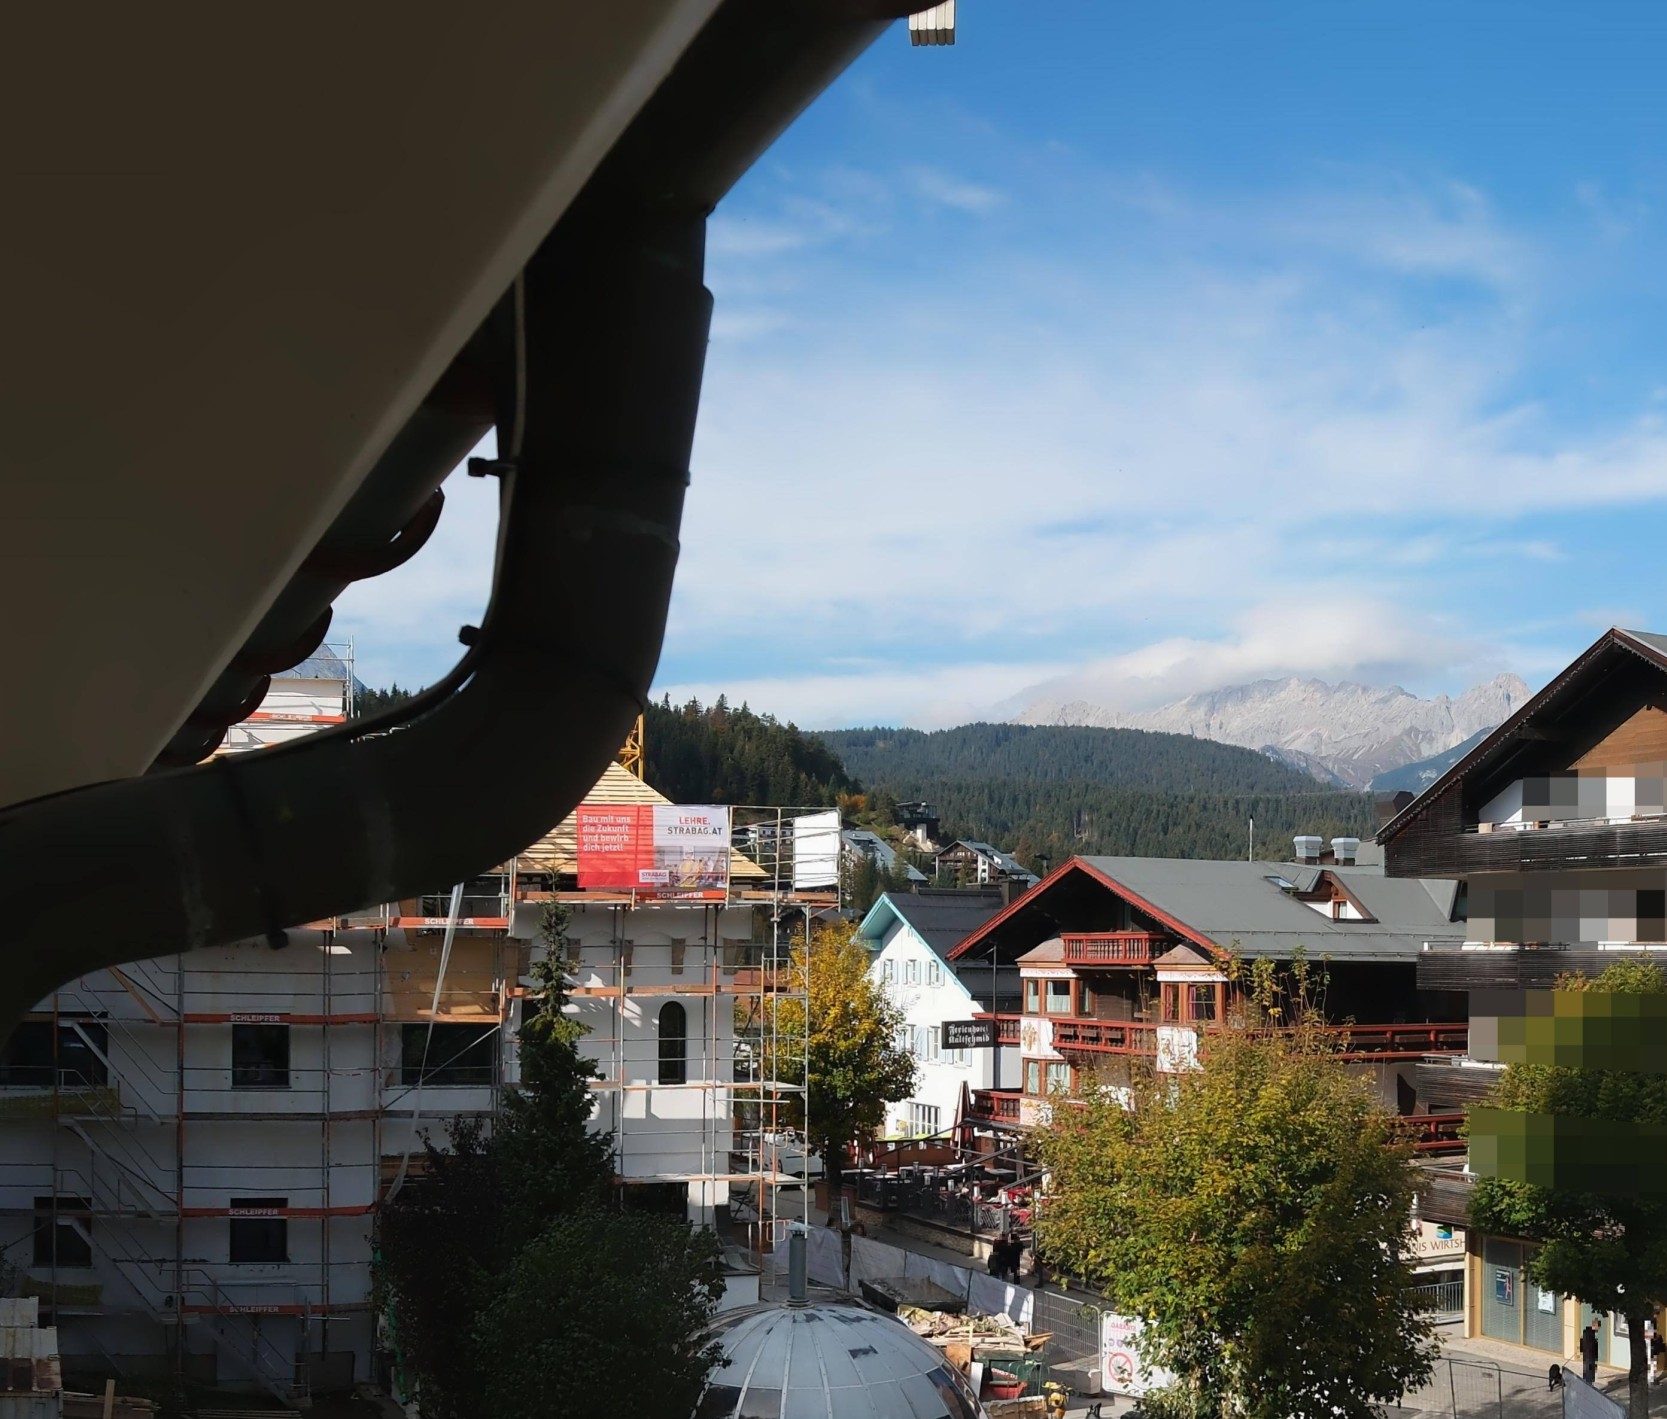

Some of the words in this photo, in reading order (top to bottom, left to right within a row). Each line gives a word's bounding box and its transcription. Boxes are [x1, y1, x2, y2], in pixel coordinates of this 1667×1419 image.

[583, 815, 598, 823] Bau
[600, 815, 616, 823] mit
[679, 816, 710, 825] LEHRE.
[583, 824, 595, 832] die
[597, 824, 629, 832] Zukunft
[667, 827, 723, 835] STRABAG.AT
[583, 834, 598, 842] und
[601, 834, 629, 842] bewirb
[584, 843, 599, 851] dich
[657, 891, 703, 899] SCHLEIPFER
